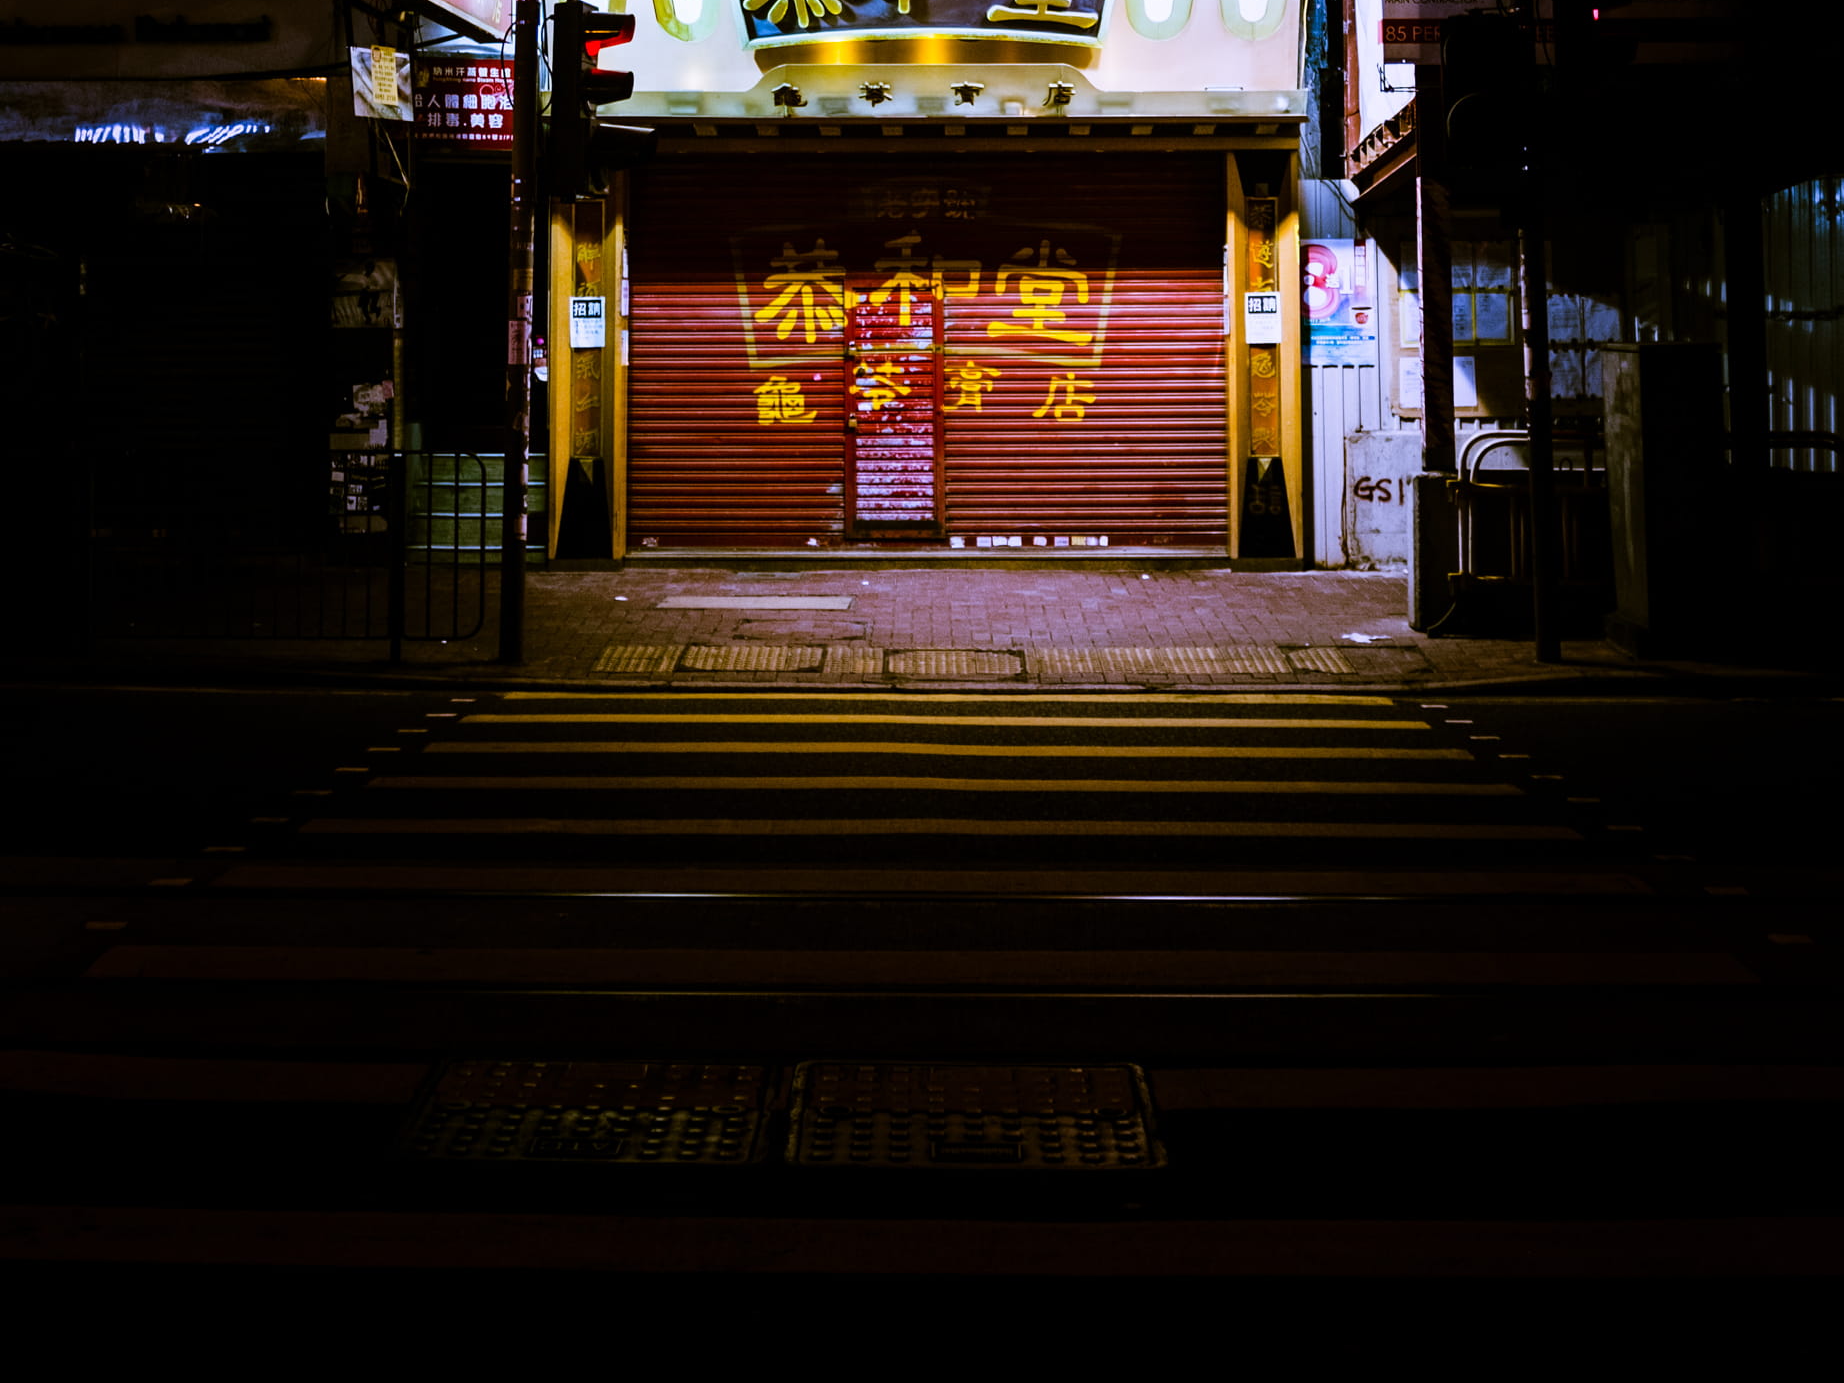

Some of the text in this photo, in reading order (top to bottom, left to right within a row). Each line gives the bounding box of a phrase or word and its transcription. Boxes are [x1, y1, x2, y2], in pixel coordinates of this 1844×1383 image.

[1385, 25, 1407, 42] 85
[753, 229, 1093, 345] 恭和堂
[752, 360, 1096, 425] 龜苓膏店
